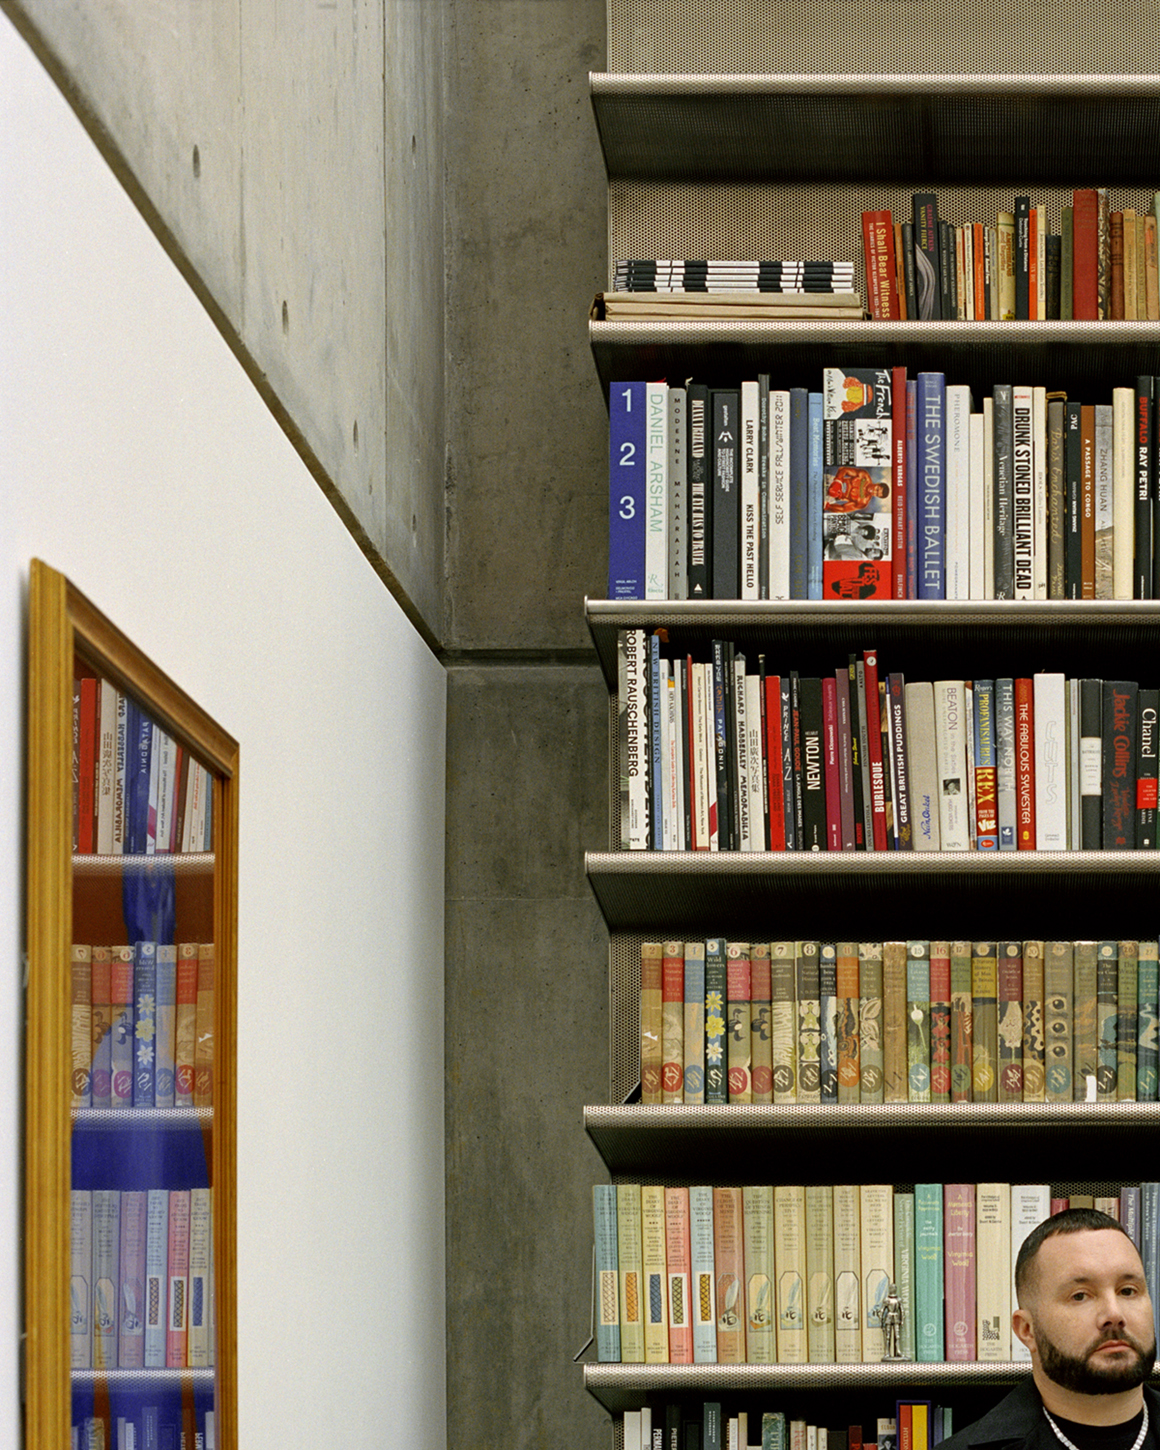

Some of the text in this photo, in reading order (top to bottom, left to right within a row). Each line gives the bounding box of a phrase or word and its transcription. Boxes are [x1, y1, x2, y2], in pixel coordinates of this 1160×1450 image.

[877, 228, 887, 253] Shall
[878, 256, 889, 278] Bear
[880, 280, 891, 318] Witness
[622, 389, 631, 412] 1
[619, 442, 635, 465] 2
[651, 394, 664, 532] DANIEL ARSHAM
[619, 496, 636, 519] 3
[924, 395, 941, 589] THE SWEDISH BALLET
[998, 455, 1008, 536] Venetian Heritage
[1015, 408, 1032, 589] DRUNK STONED BRILLIANT DEAD
[627, 629, 639, 777] ROBERT RAUSCHENBERG
[947, 687, 958, 730] BEATON
[1113, 689, 1130, 777] Jackie Collins
[1141, 708, 1157, 758] Chanel
[806, 736, 820, 790] NEWTON
[976, 769, 994, 804] REX
[1019, 703, 1031, 824] THE FABULOUS SYLVESTER
